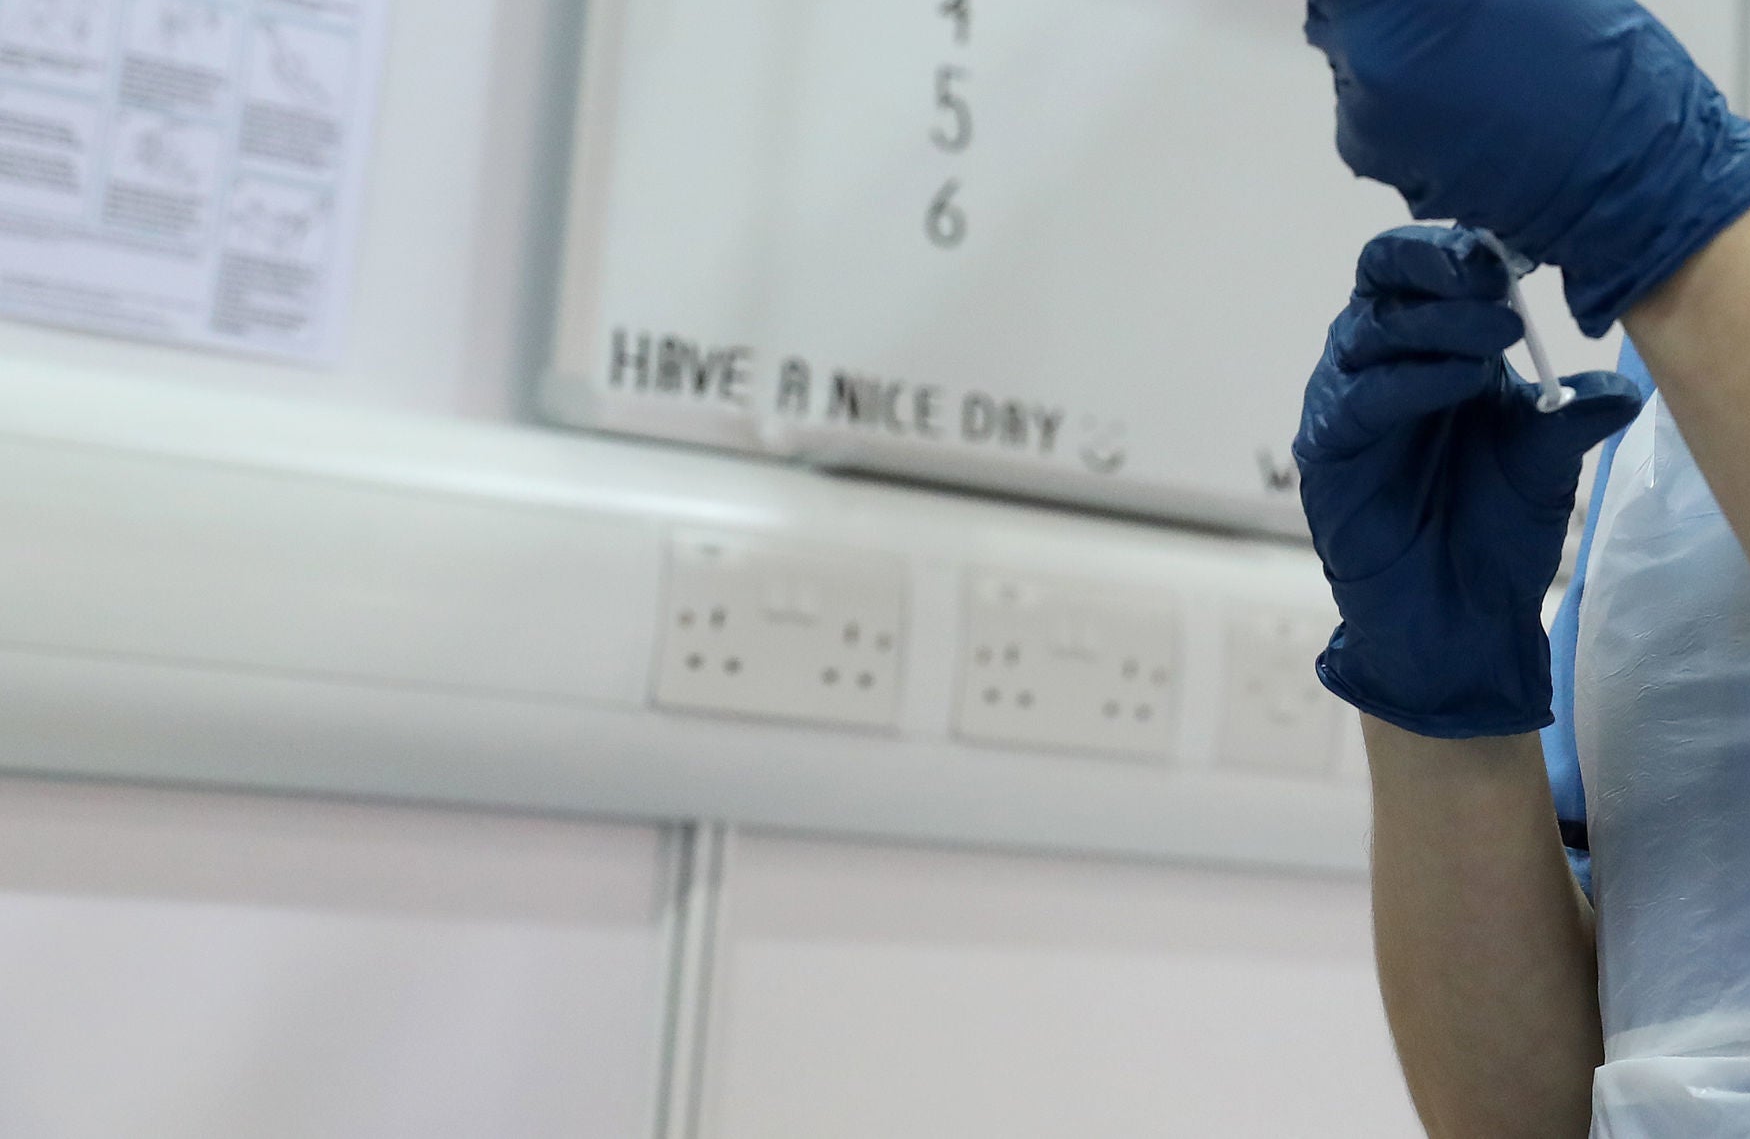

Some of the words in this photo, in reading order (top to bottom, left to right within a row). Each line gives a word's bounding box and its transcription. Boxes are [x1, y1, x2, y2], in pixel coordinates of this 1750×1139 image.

[929, 63, 974, 154] 5
[924, 176, 968, 249] 6
[607, 326, 753, 406] HAVE
[774, 356, 811, 417] A
[825, 367, 943, 439] NICE
[959, 394, 1066, 454] DAY
